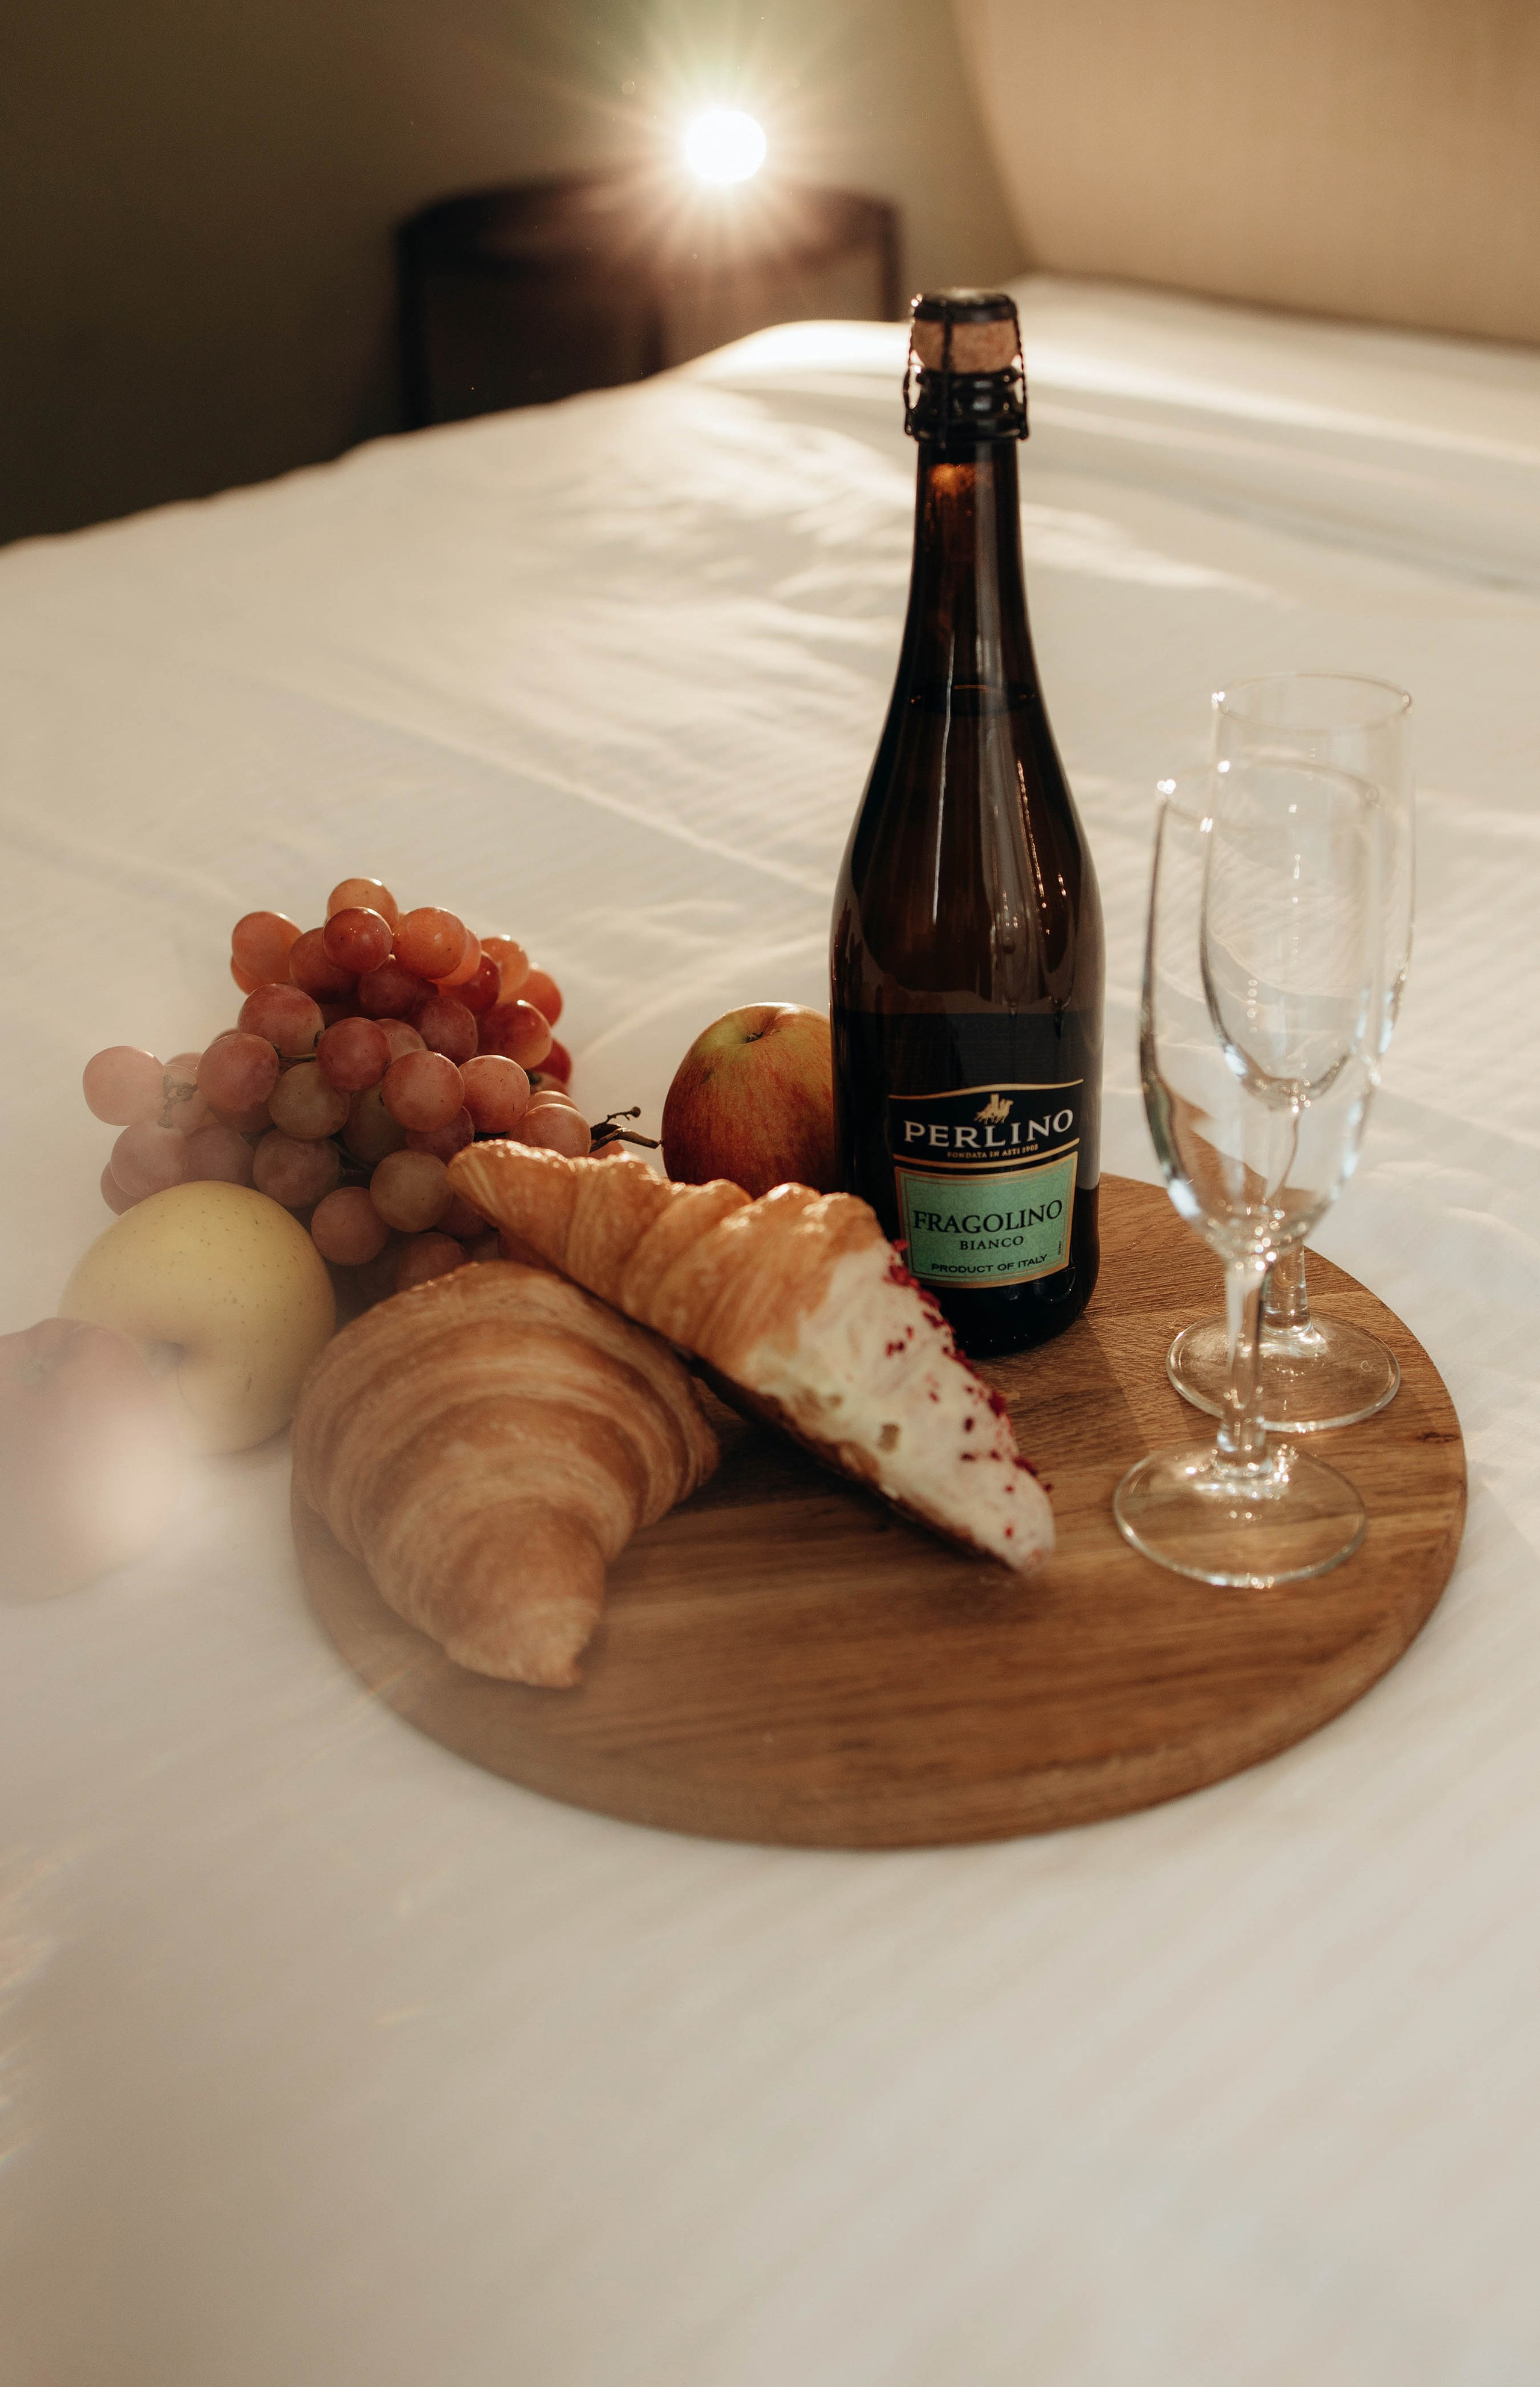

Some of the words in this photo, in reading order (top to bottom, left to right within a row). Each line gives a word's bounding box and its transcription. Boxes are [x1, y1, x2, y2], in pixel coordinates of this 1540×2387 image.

[903, 1109, 1074, 1149] PERLINO
[1002, 1147, 1021, 1157] ASTI
[913, 1199, 1064, 1234] FRAGOLINO
[959, 1236, 1024, 1250] BIANCO
[931, 1264, 993, 1274] PRODUCT
[997, 1263, 1016, 1271] OF
[1018, 1253, 1048, 1267] ITALY
